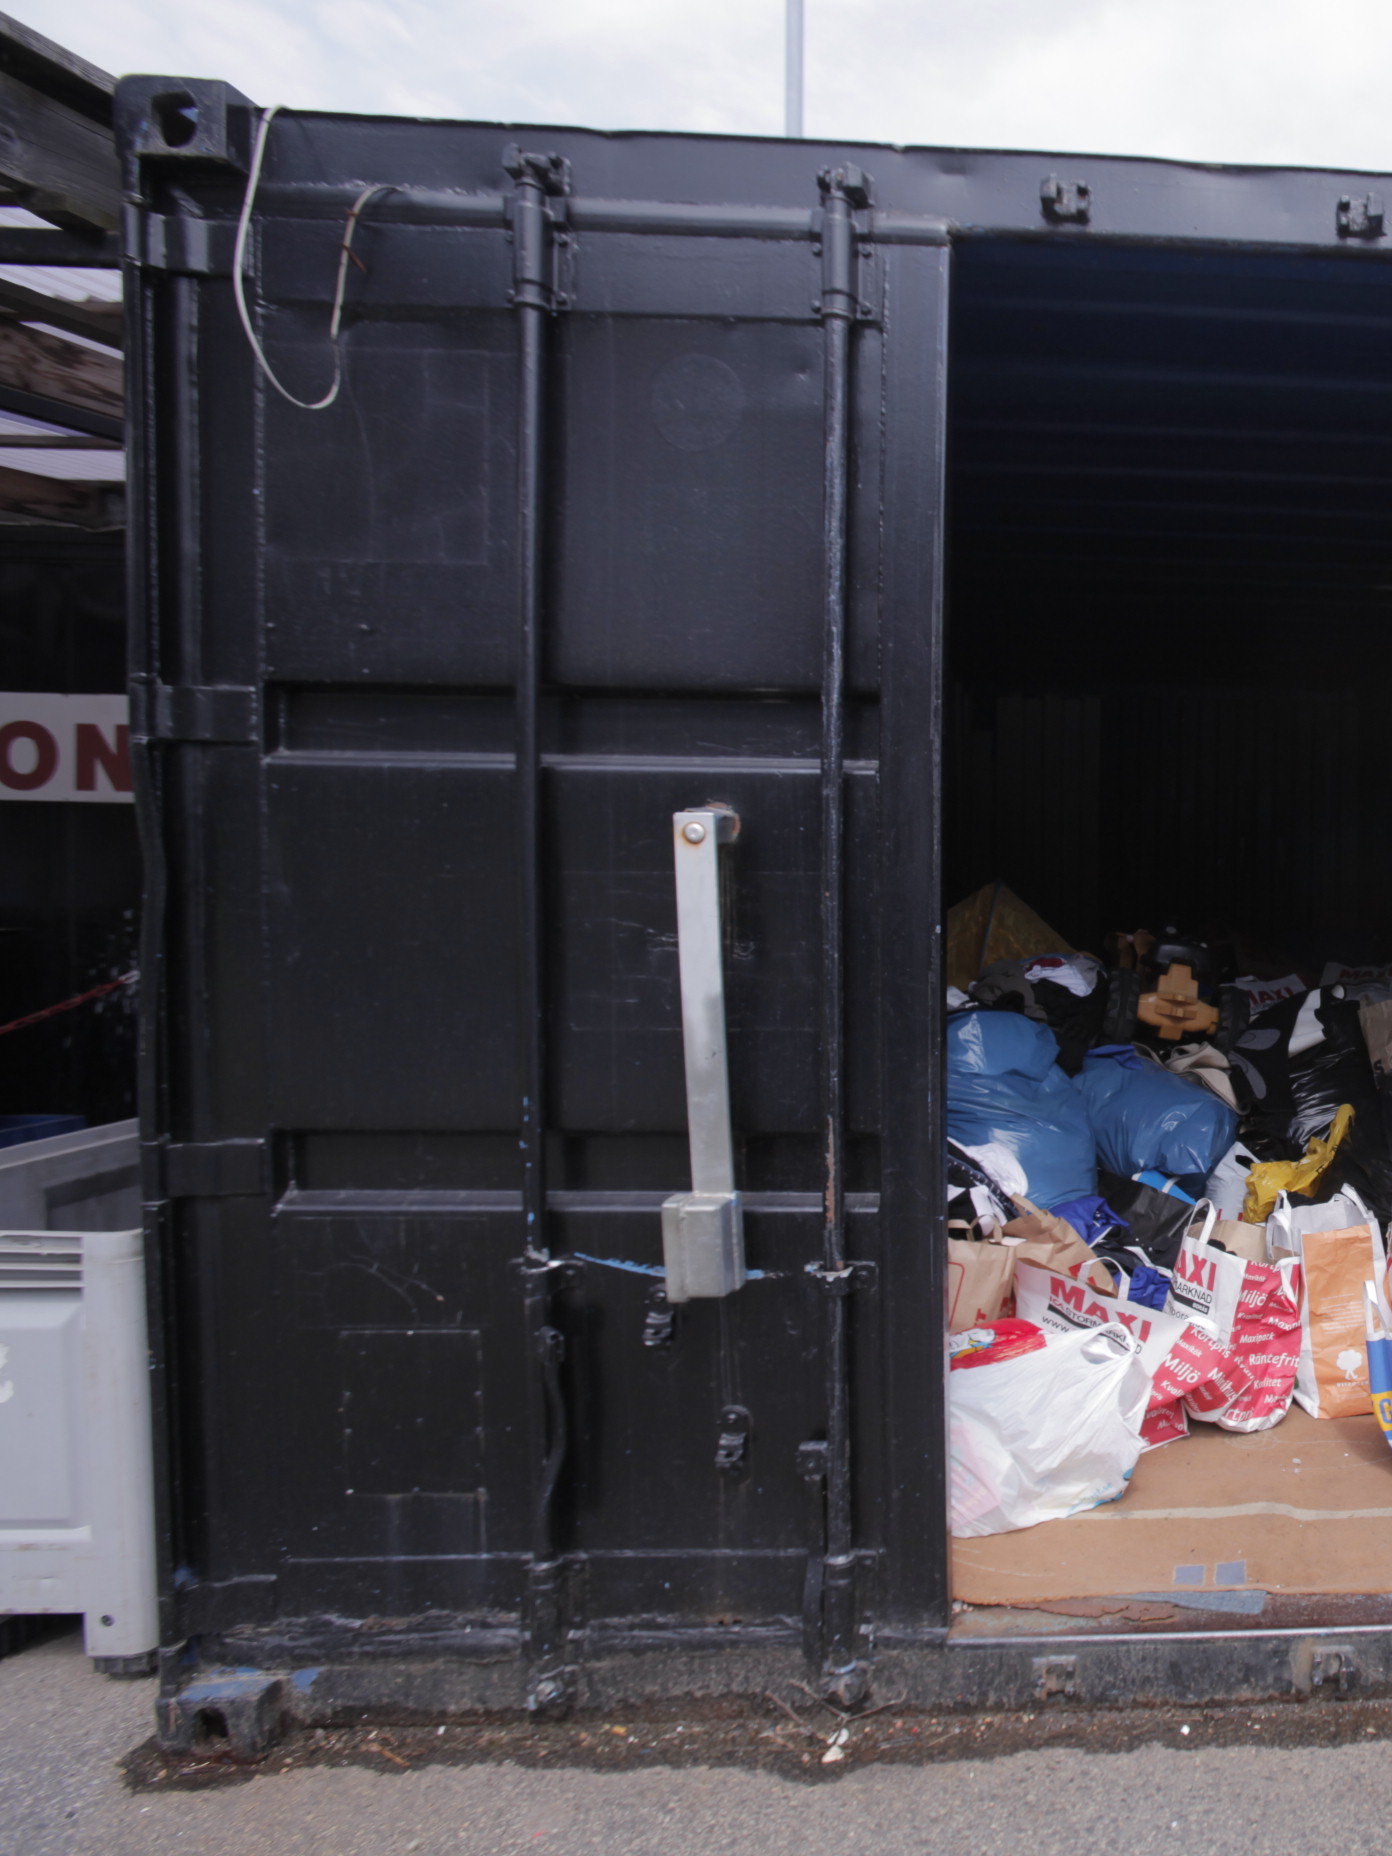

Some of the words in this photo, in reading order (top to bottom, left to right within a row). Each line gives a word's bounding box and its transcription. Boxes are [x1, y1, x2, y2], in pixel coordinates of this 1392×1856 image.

[1175, 1249, 1217, 1292] AXI
[1050, 1276, 1152, 1343] MAXI
[1164, 1353, 1201, 1383] Miljö
